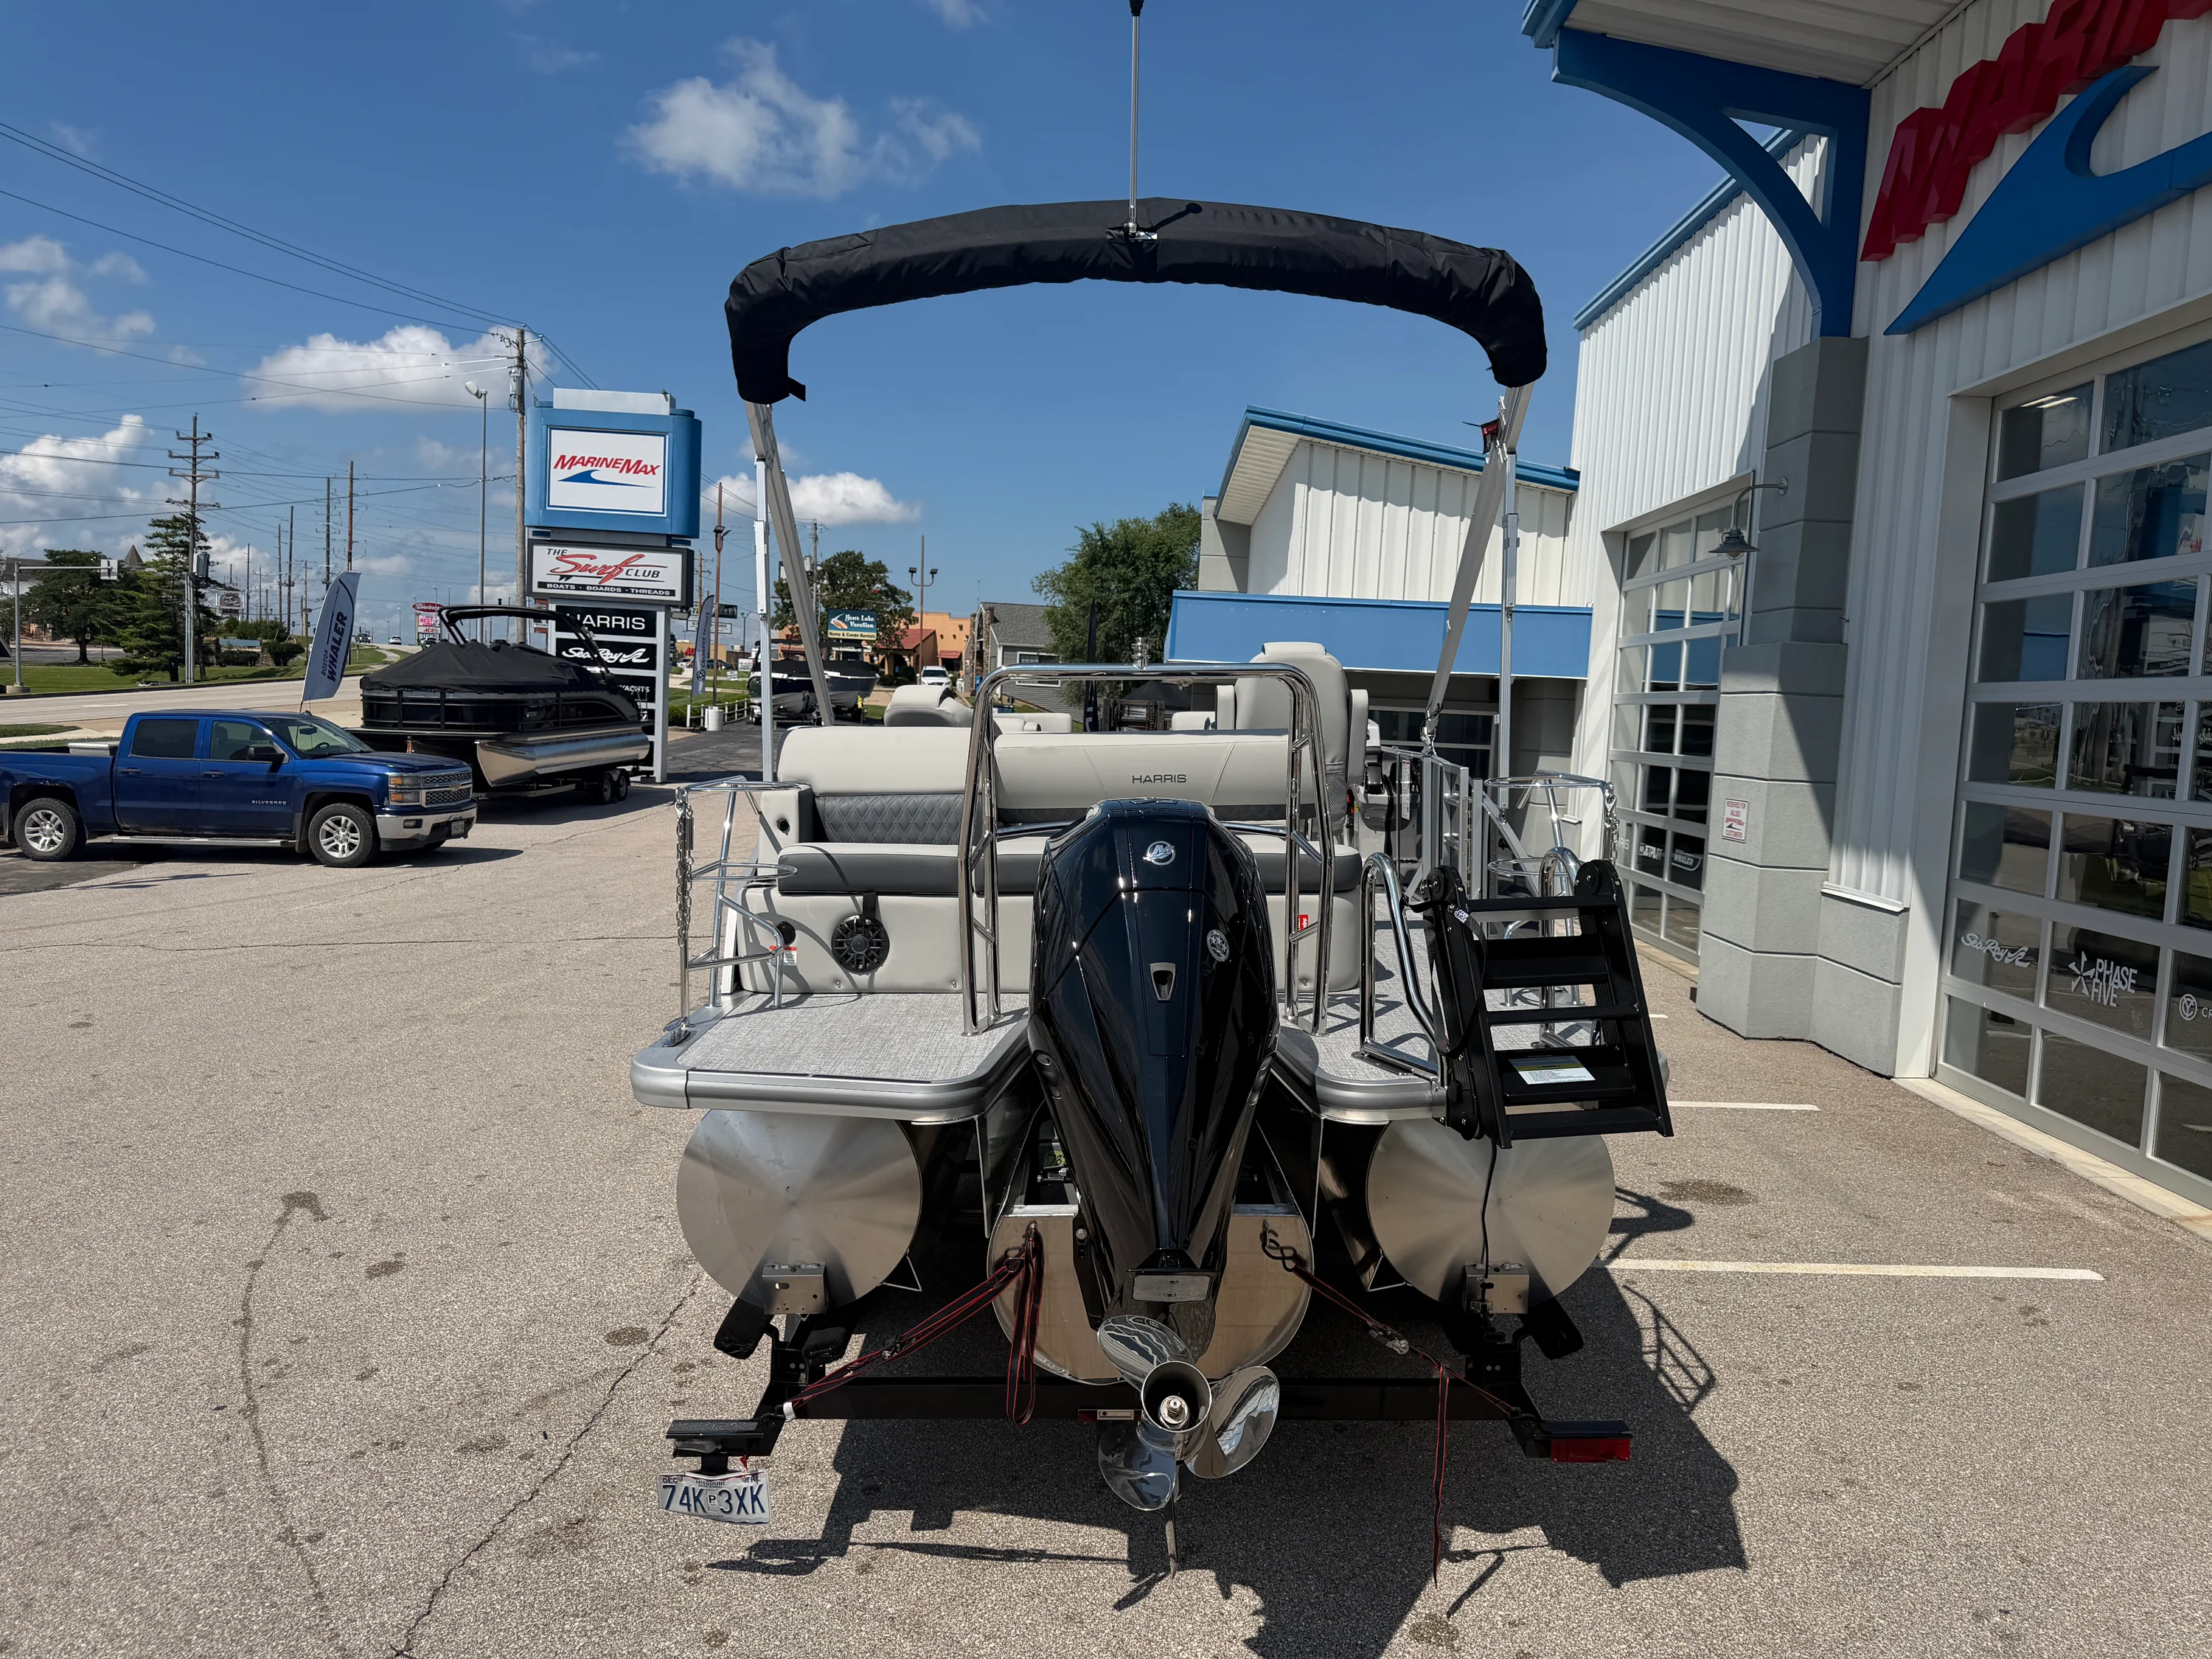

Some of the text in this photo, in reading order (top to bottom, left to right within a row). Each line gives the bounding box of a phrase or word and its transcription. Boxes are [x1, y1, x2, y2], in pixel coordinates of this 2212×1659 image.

[546, 548, 568, 556] THE
[549, 554, 668, 585] Surf CLUB
[630, 588, 670, 596] THREADS
[577, 613, 646, 630] ARRIS
[844, 613, 875, 622] Your Lake
[327, 611, 348, 683] WHALER
[321, 649, 329, 677] BOSTON
[1132, 773, 1187, 784] HARRIS
[1961, 933, 2009, 961] Sea Ray
[2095, 959, 2138, 994] PHASE
[2091, 978, 2118, 1007] FIVE
[662, 1476, 678, 1484] DEC
[662, 1484, 708, 1514] 74K
[717, 1484, 766, 1515] 3XK
